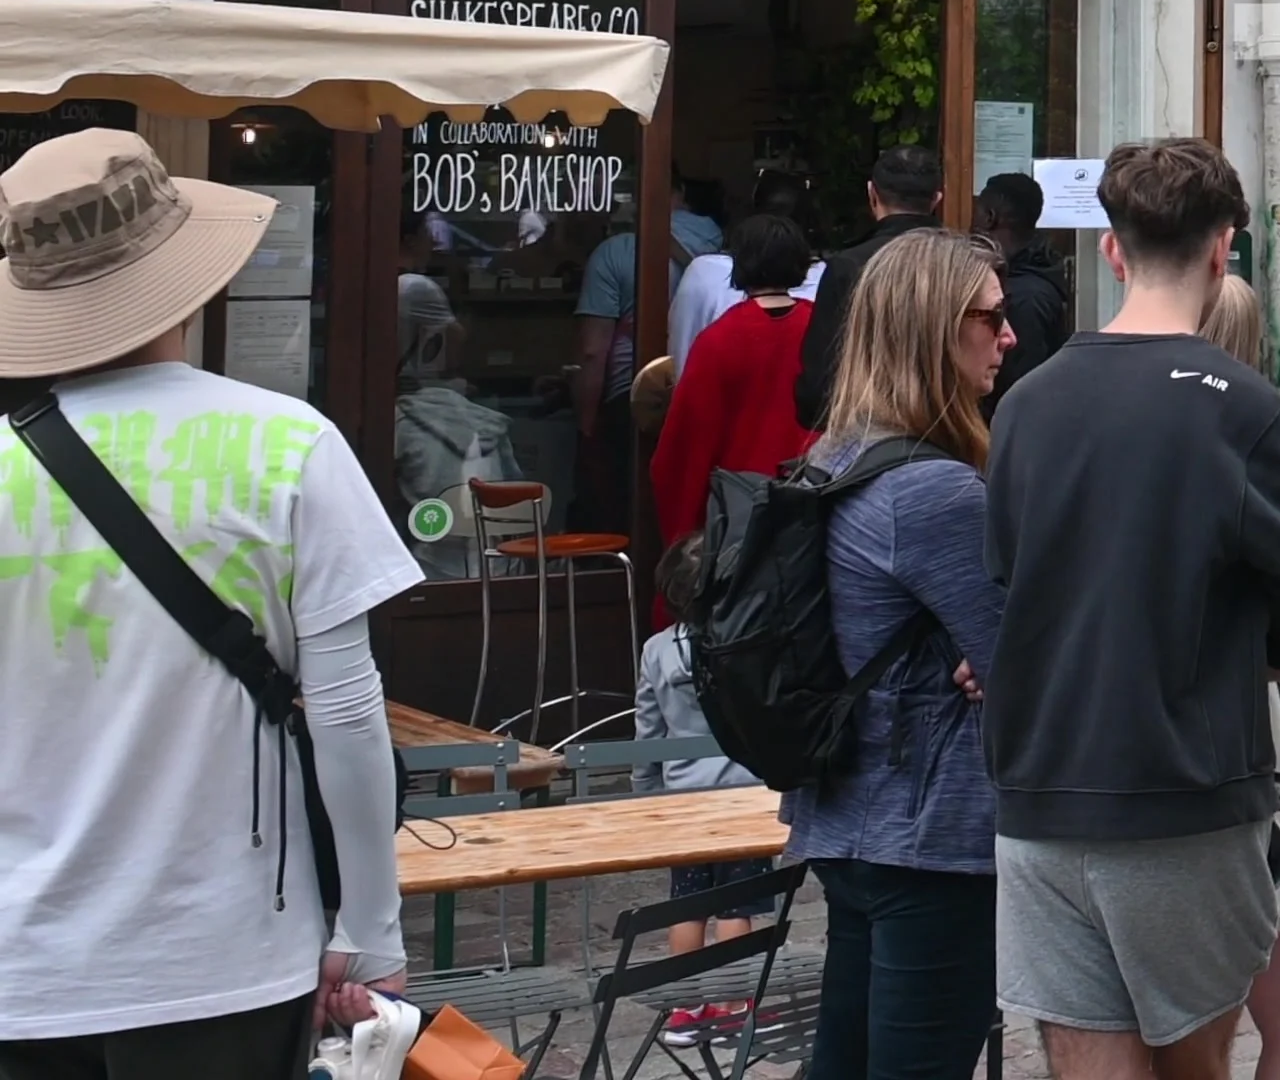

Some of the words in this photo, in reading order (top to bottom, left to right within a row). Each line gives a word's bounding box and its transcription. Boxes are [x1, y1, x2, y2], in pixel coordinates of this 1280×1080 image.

[413, 122, 429, 144] IN
[440, 121, 547, 145] COLLABORATION
[555, 125, 598, 148] WITH
[500, 153, 622, 213] BAKESHOP
[1201, 374, 1229, 392] AIR
